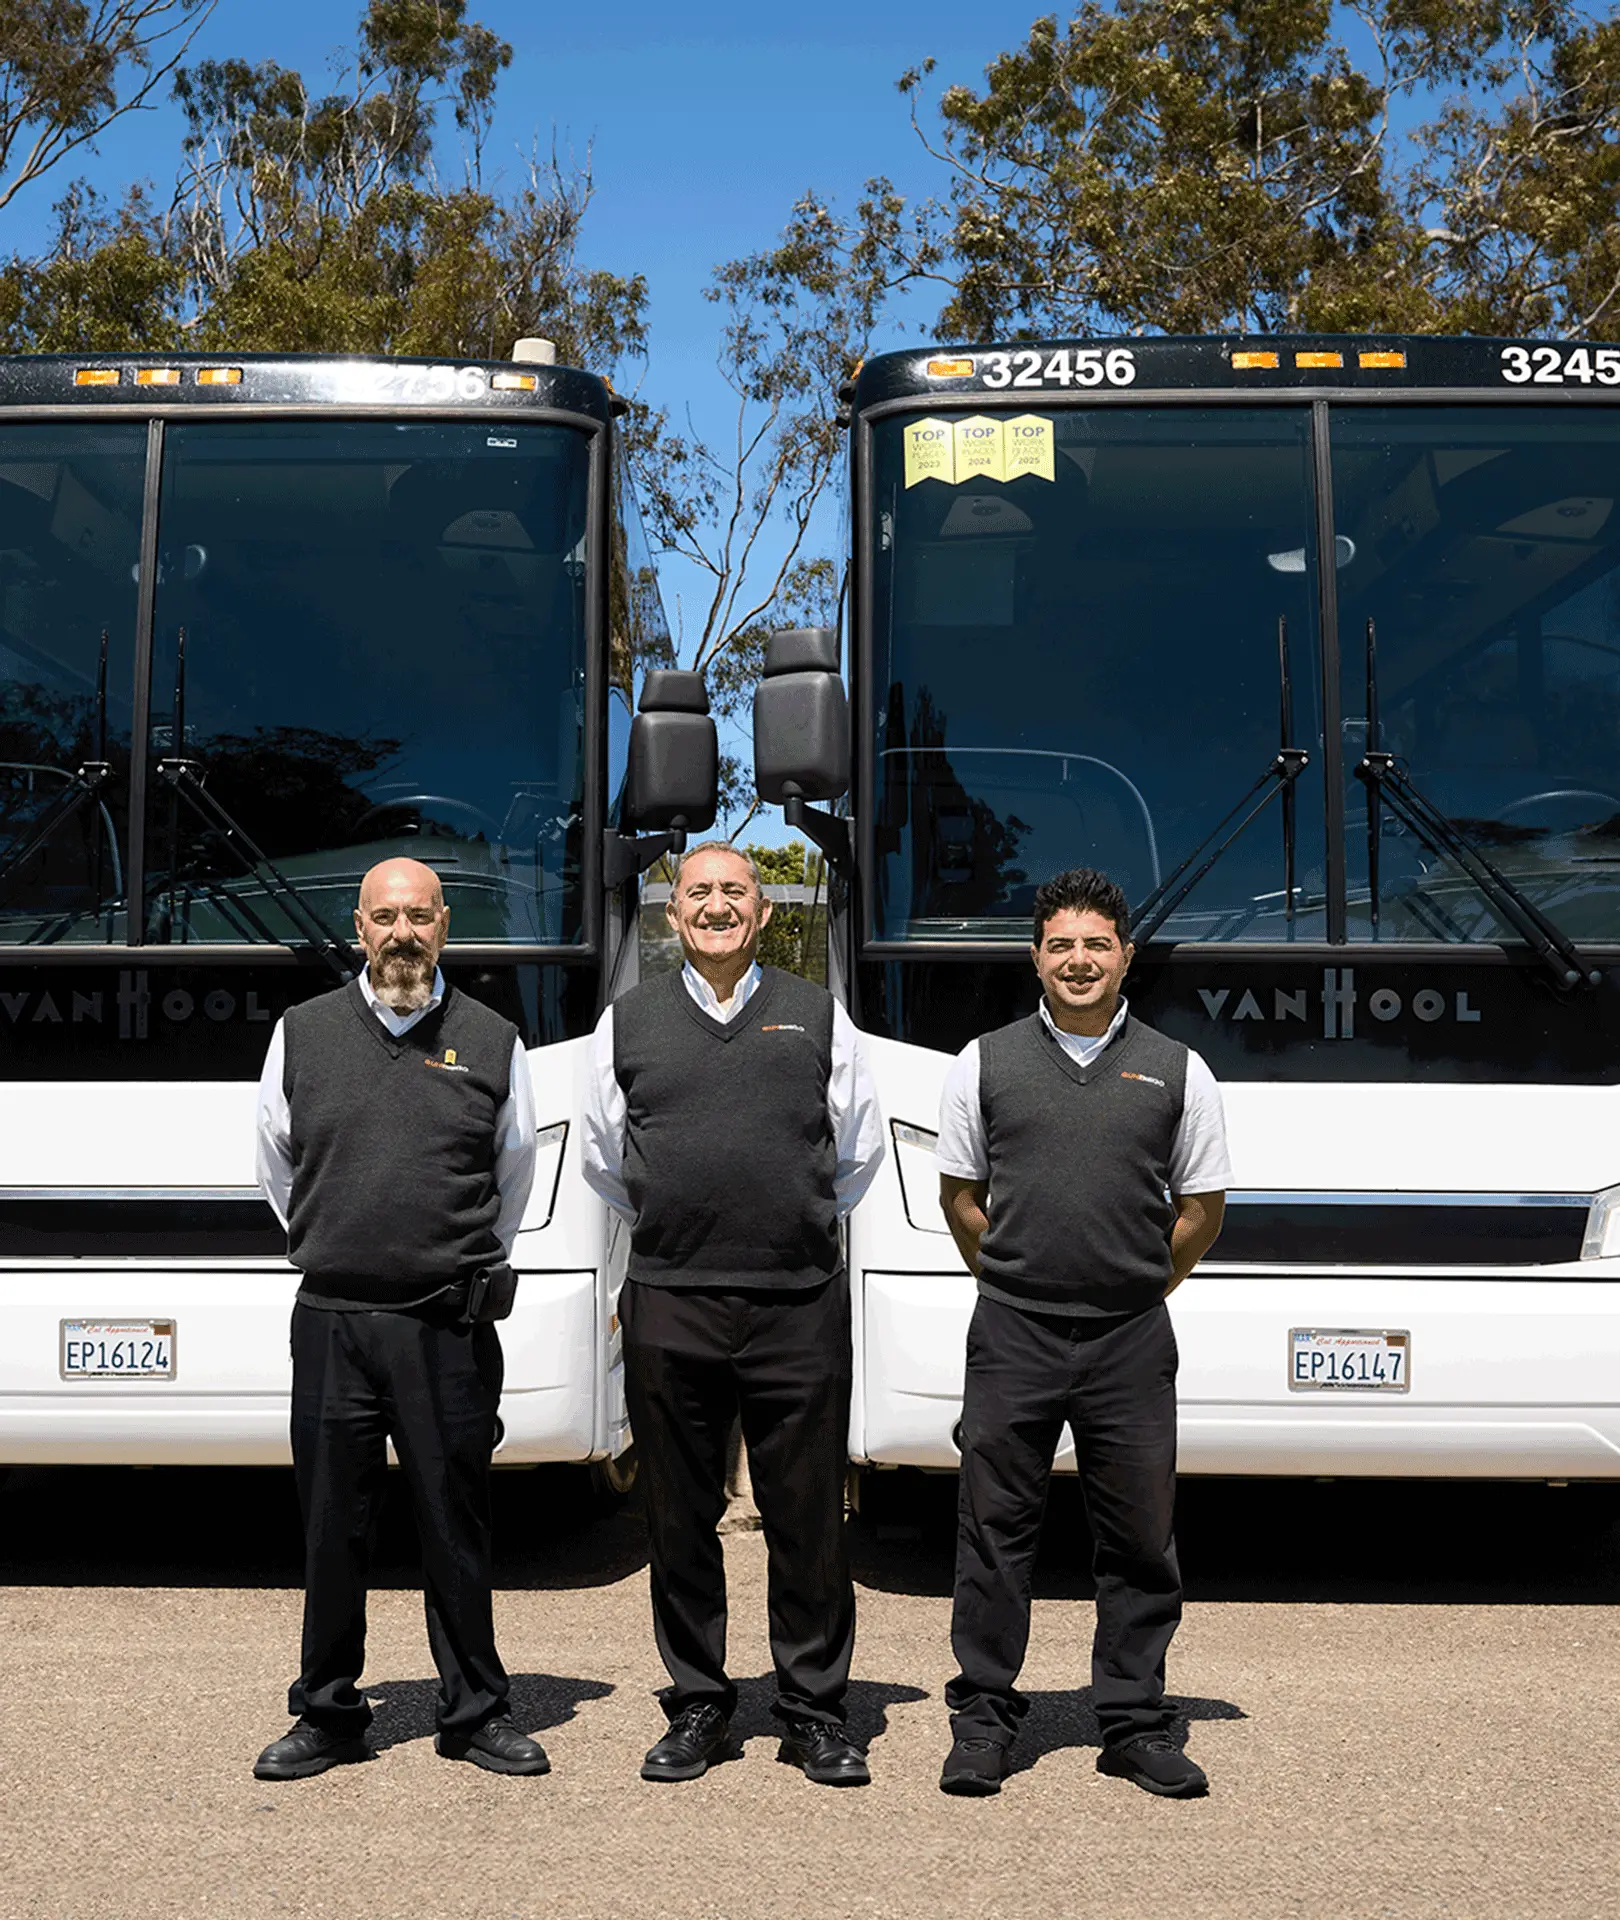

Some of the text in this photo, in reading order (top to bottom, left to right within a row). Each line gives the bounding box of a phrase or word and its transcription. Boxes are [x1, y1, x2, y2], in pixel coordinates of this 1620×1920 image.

[982, 349, 1136, 388] 32456
[912, 430, 945, 442] TOP
[962, 427, 995, 439] TOP
[1012, 426, 1045, 437] TOP
[962, 438, 995, 448] WORK
[1012, 438, 1045, 447] WORK
[968, 457, 991, 466] 2024
[1018, 455, 1041, 465] 2025
[67, 1341, 168, 1369] EP16124
[1295, 1351, 1402, 1381] EP16147
